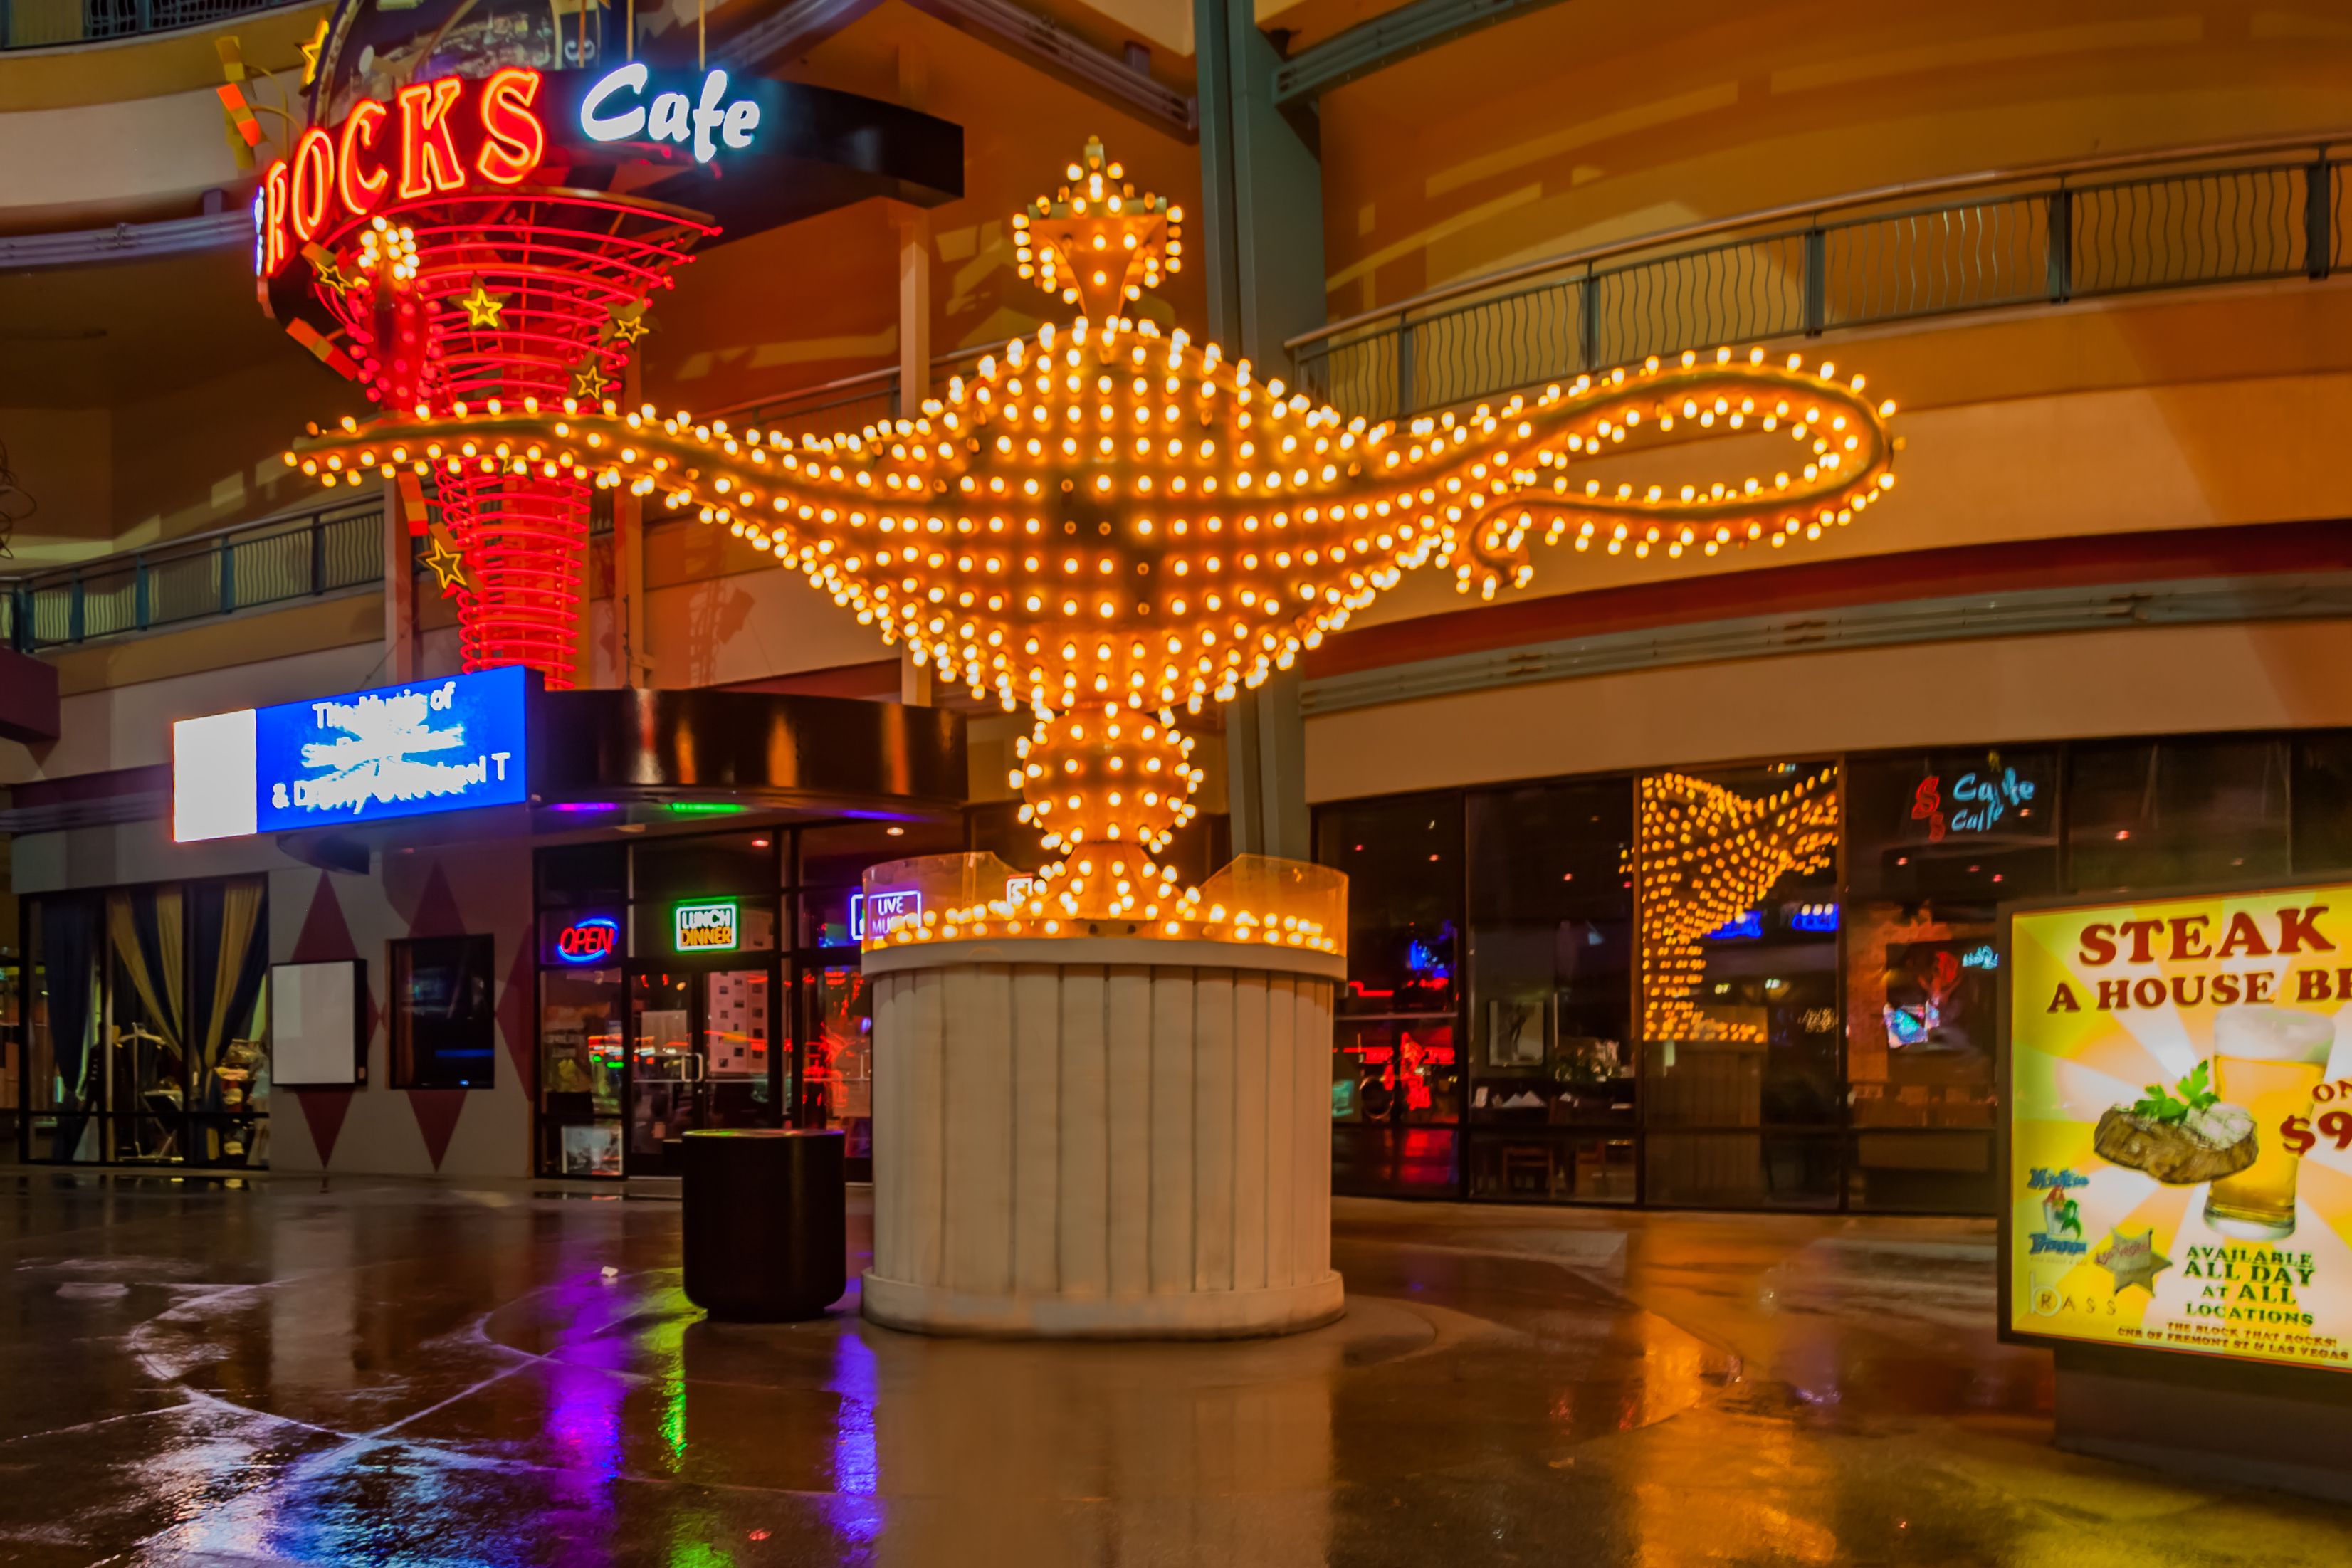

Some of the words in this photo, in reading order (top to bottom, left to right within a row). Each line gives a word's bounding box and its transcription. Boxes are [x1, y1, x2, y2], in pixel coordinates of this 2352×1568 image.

[266, 68, 543, 276] ROCKS
[581, 63, 761, 164] Cafe
[430, 681, 456, 711] of
[271, 782, 290, 809] &
[491, 752, 511, 781] T
[878, 895, 904, 916] LIVE
[681, 909, 732, 930] LUNCH
[560, 926, 616, 954] OPEN
[681, 927, 733, 946] DINNER
[2079, 905, 2336, 967] STEAK
[2047, 982, 2081, 1014] A
[2096, 972, 2275, 1011] HOUSE
[2186, 1245, 2313, 1266] AVAILABLE
[2183, 1260, 2241, 1280] ALL
[2250, 1264, 2315, 1286] DAY
[2202, 1285, 2229, 1298] AT
[2237, 1283, 2297, 1305] ALL
[2185, 1303, 2314, 1327] LOCATIONS
[2117, 1327, 2143, 1338] CNR
[2146, 1330, 2163, 1340] OF
[2167, 1333, 2230, 1347] FREMONT
[2233, 1340, 2250, 1349] ST
[2254, 1342, 2264, 1352] &
[2269, 1344, 2295, 1355] LAS
[2299, 1347, 2349, 1361] VEGAS
[2168, 1322, 2191, 1332] THE
[2196, 1325, 2239, 1337] BLOCK
[2245, 1330, 2279, 1342] THAT
